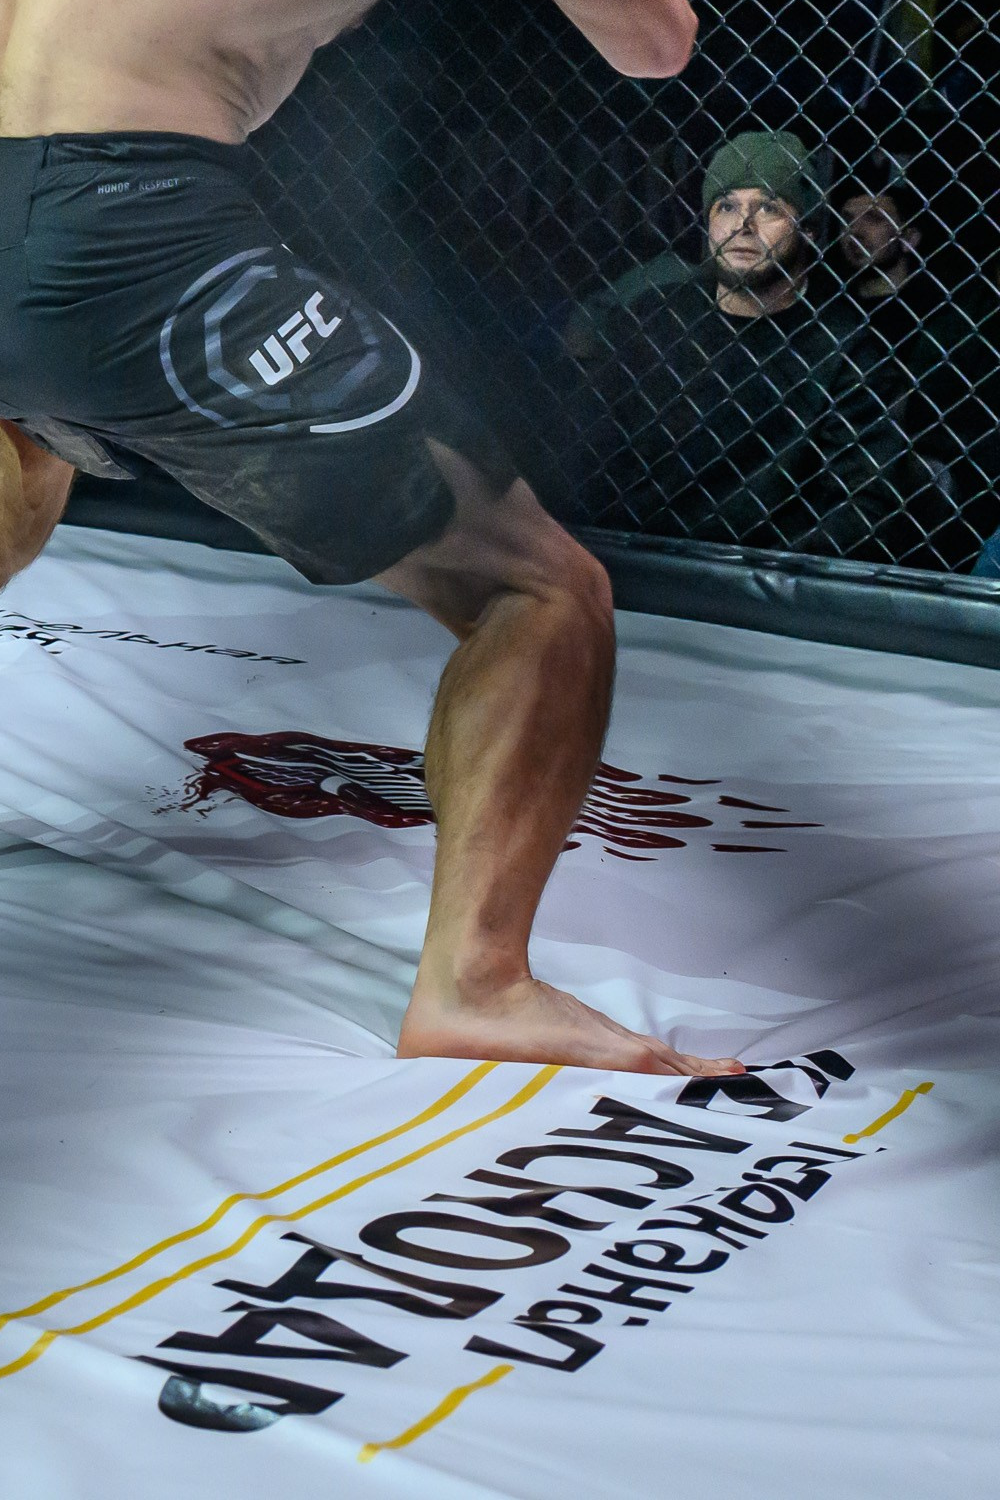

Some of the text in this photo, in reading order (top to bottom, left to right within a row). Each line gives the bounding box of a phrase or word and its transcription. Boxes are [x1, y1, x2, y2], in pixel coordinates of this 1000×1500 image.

[97, 182, 130, 195] HONOR
[138, 177, 180, 192] RESPECT
[247, 290, 342, 386] UFC
